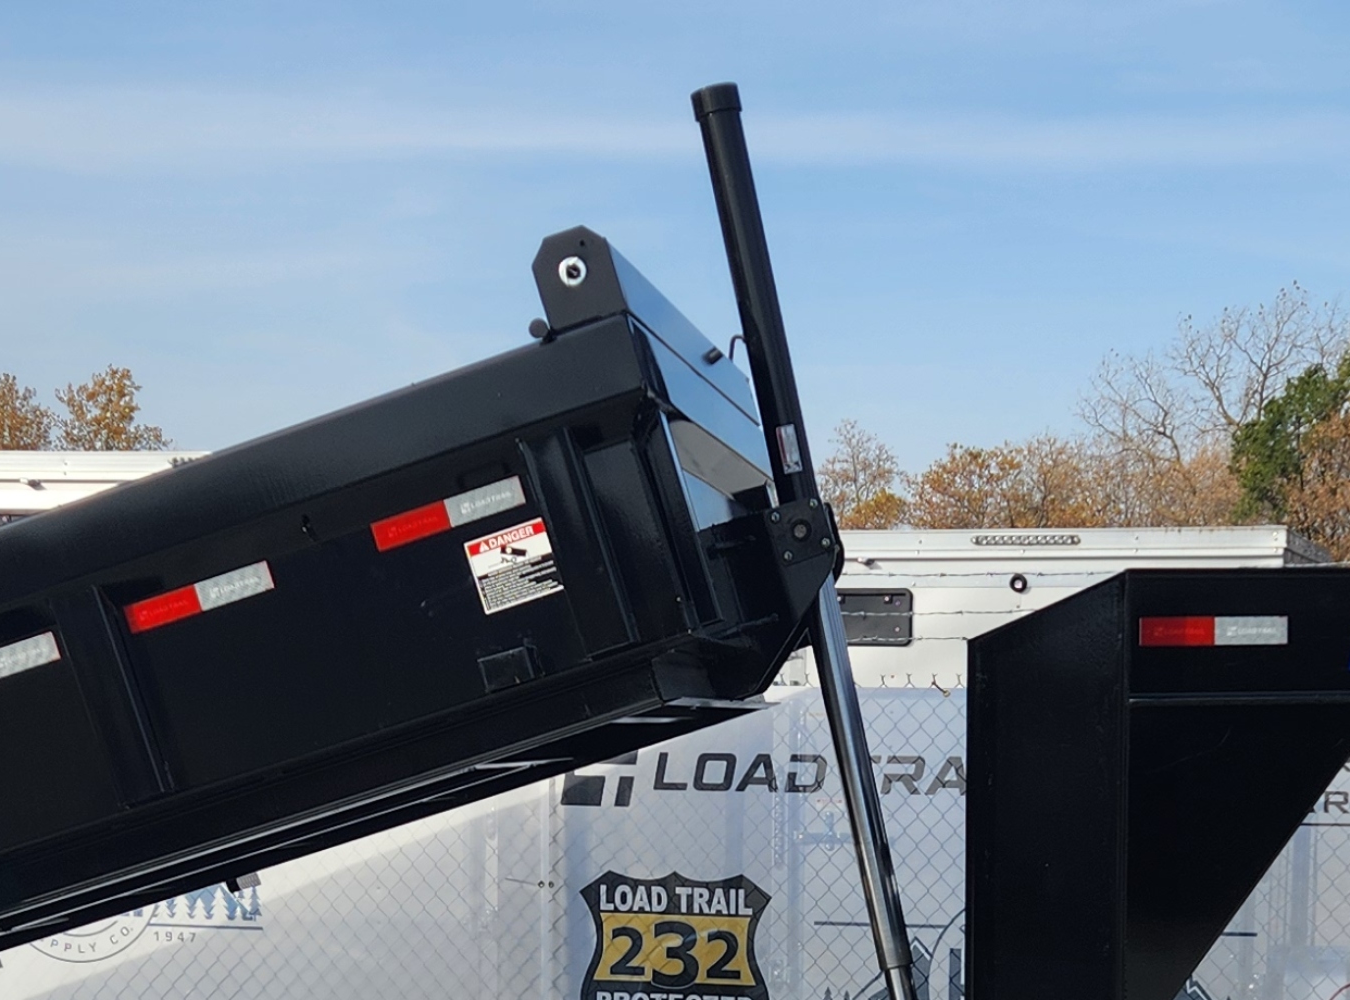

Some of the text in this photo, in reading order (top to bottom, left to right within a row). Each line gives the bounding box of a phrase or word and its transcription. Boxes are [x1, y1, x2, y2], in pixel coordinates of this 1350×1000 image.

[488, 525, 535, 548] DANGER
[653, 751, 828, 793] LOAD
[600, 884, 753, 916] LOAD TRAIL
[109, 925, 135, 946] CO.
[153, 931, 197, 943] 1947
[609, 920, 742, 988] 232
